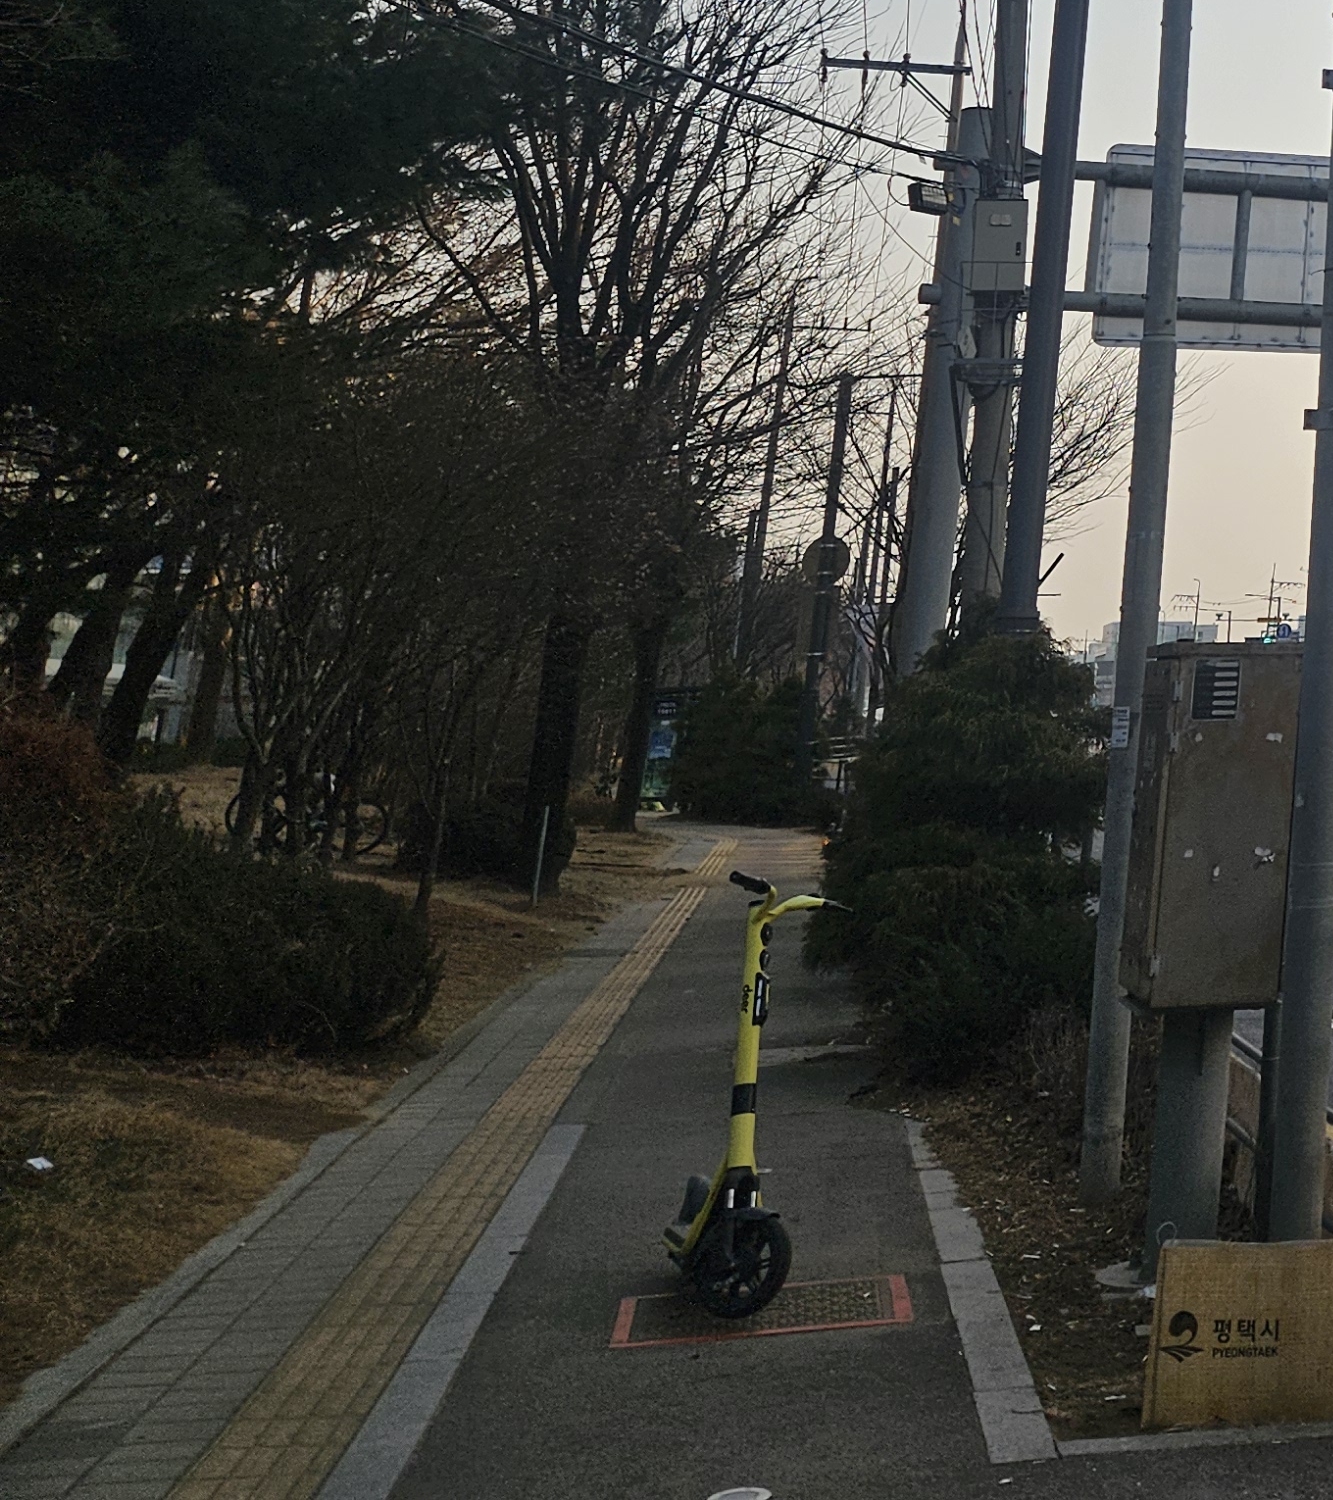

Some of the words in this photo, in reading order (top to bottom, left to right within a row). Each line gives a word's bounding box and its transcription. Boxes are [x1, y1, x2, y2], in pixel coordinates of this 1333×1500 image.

[741, 984, 753, 1014] deer
[1213, 1318, 1280, 1344] 평택시
[1212, 1346, 1278, 1358] PYEONGTAEK
